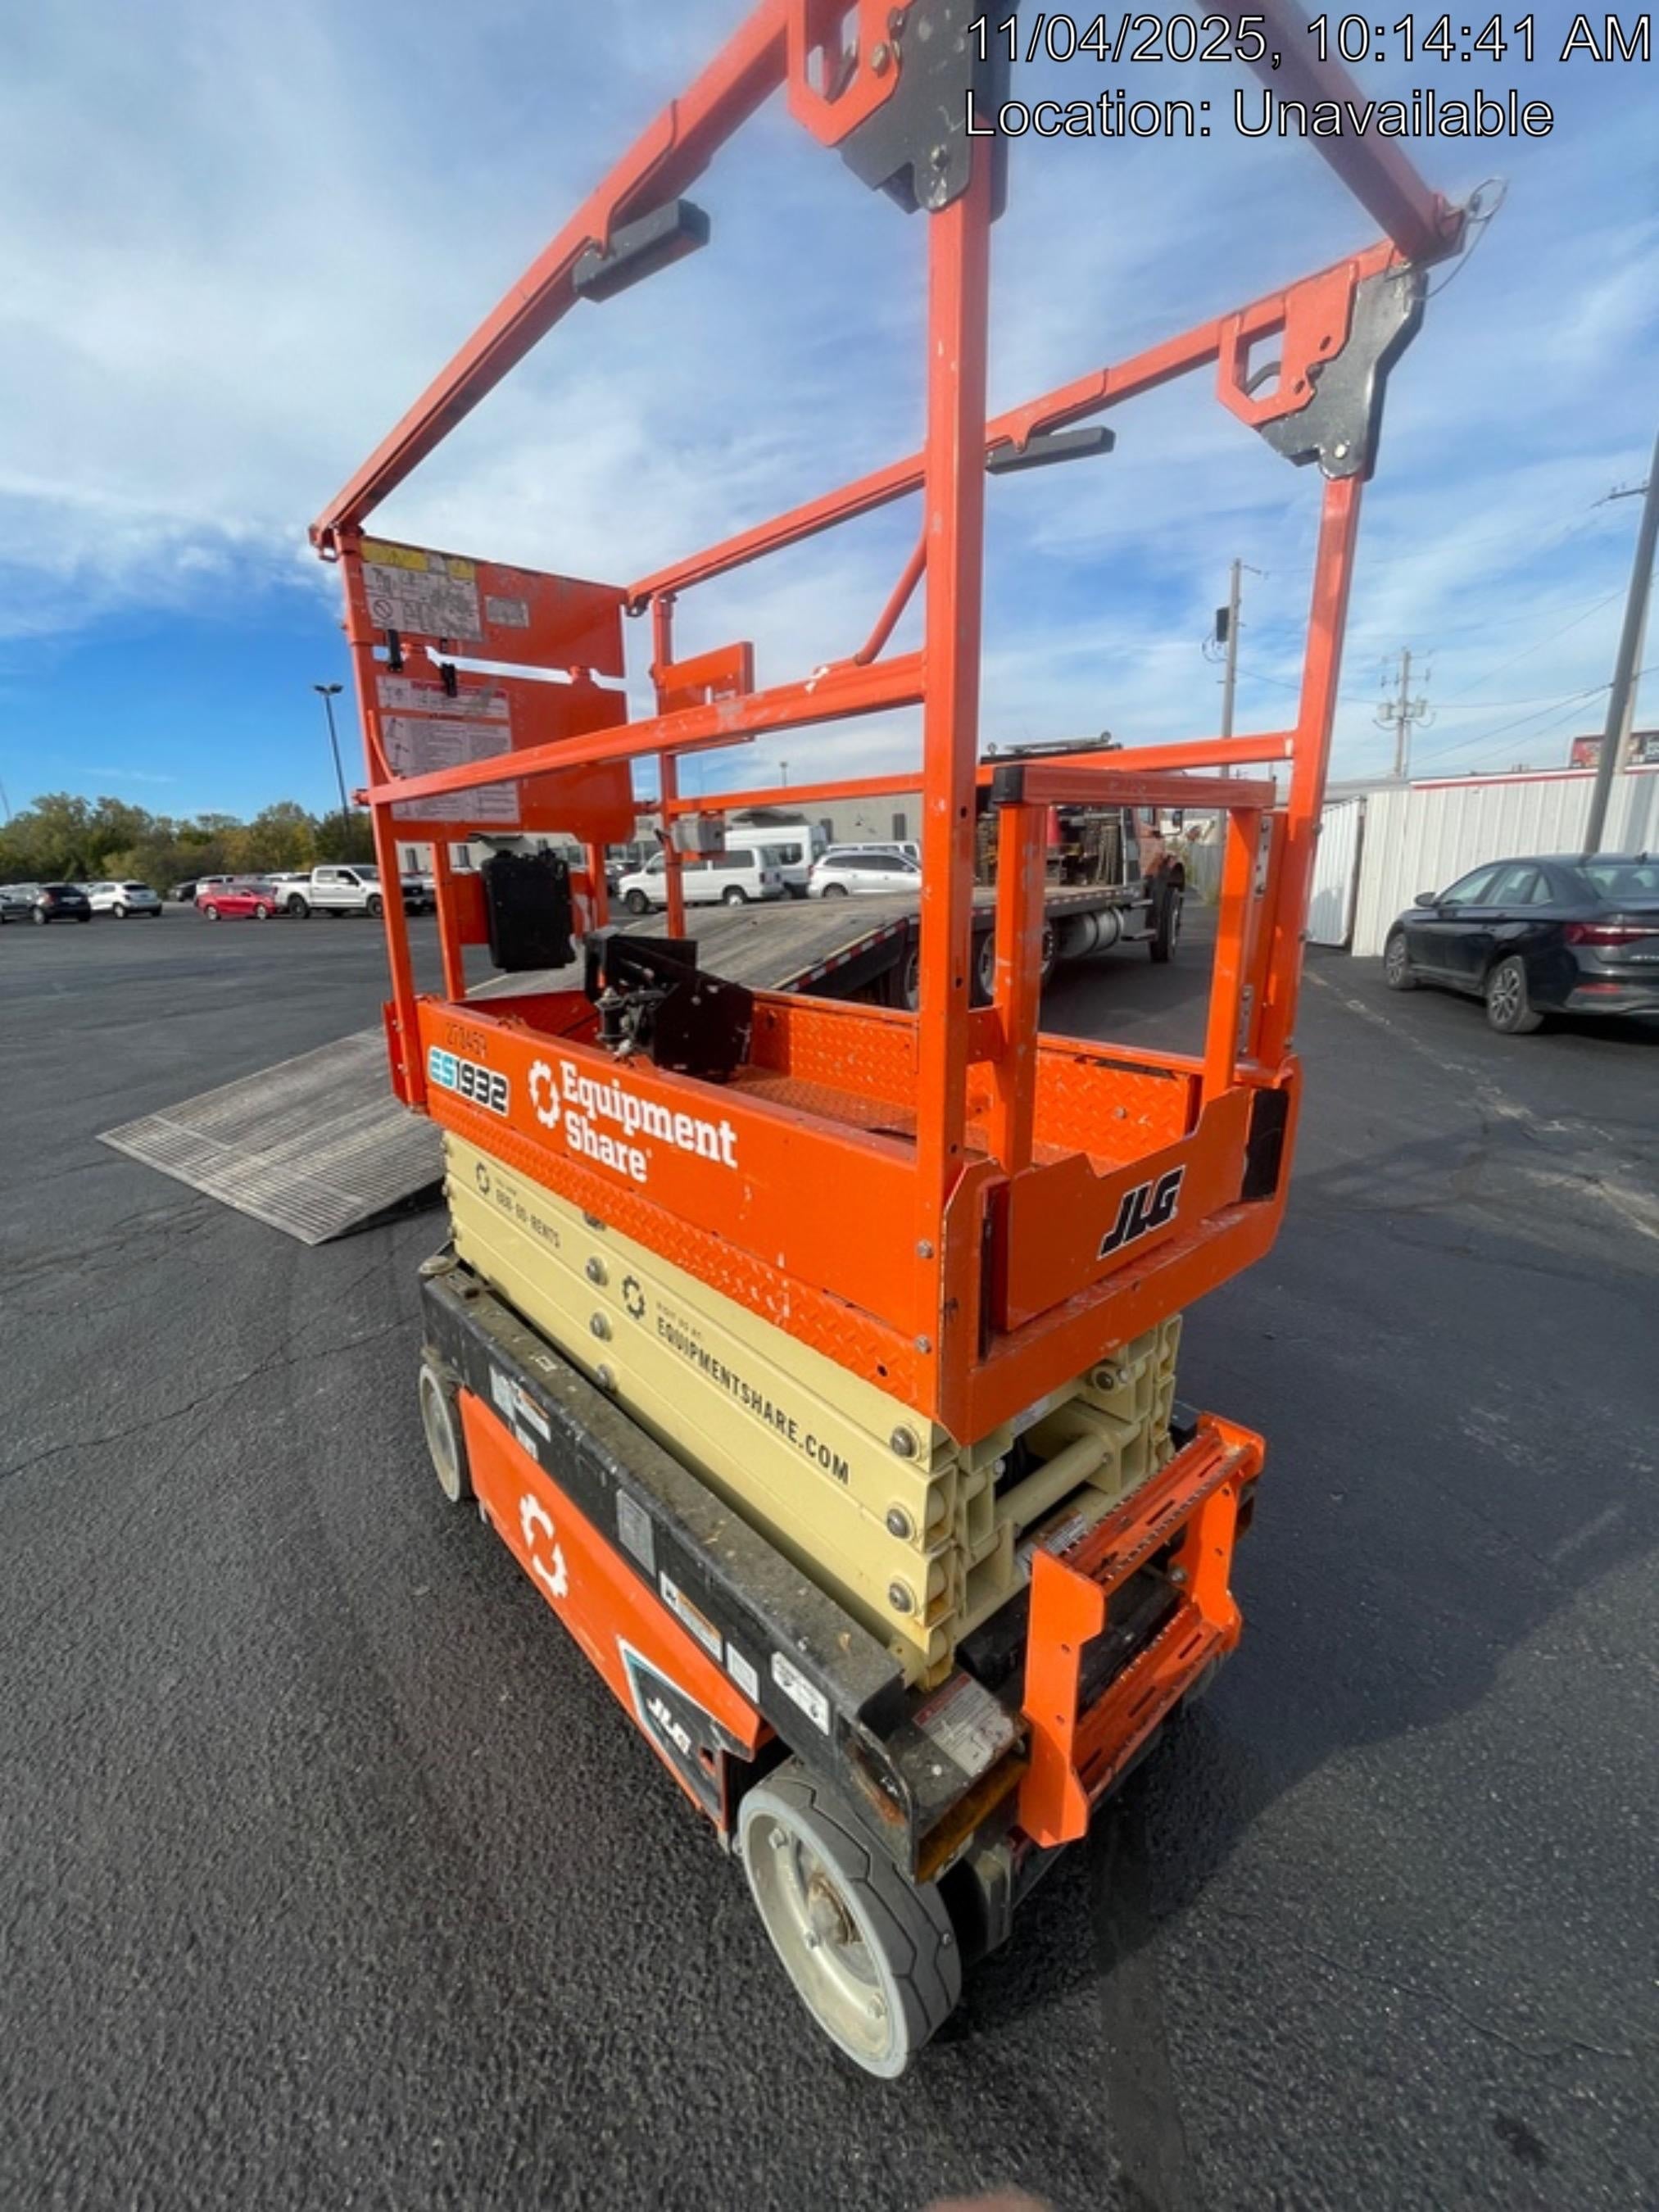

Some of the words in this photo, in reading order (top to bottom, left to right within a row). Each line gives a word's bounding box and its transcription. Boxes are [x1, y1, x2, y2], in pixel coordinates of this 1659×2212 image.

[431, 1048, 508, 1113] ES1932
[560, 1060, 737, 1169] Equipment
[564, 1109, 647, 1183] Share
[1096, 1164, 1185, 1261] JLG
[658, 1317, 849, 1484] EQUIPMENTSHARE.COM
[646, 1697, 691, 1755] JLG
